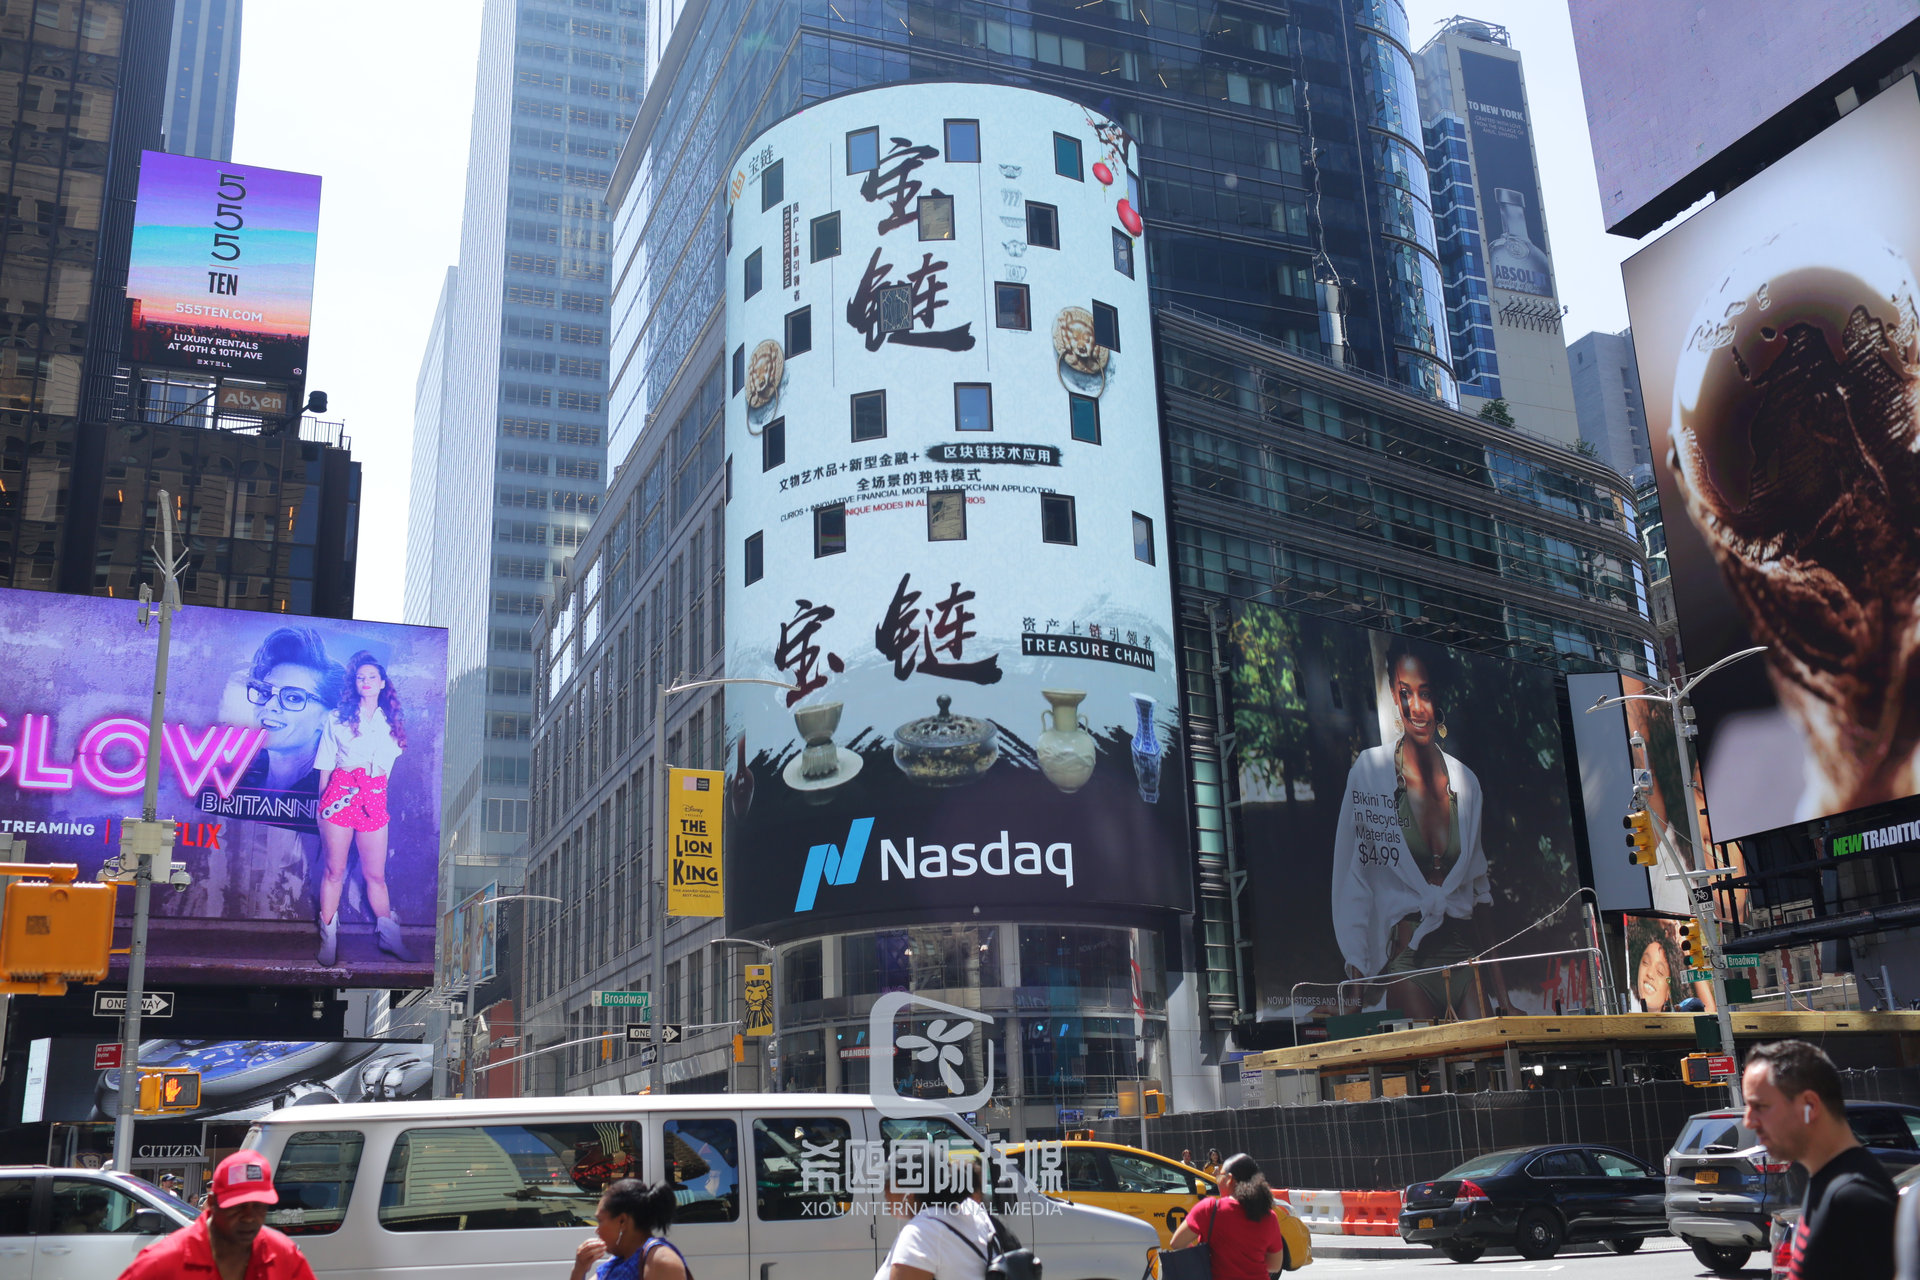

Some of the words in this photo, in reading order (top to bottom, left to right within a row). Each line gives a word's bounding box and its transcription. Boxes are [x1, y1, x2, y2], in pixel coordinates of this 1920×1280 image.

[1468, 100, 1479, 110] TO
[1481, 104, 1499, 115] NEW
[208, 271, 238, 296] TEN
[176, 303, 263, 322] 555TEN.COM
[174, 333, 214, 344] LUXURY
[216, 338, 258, 350] RENTALS
[183, 345, 208, 354] 40TH
[210, 347, 216, 355] &
[219, 348, 241, 358] 10TH
[243, 351, 263, 360] AVE
[224, 391, 282, 411] Absen
[943, 445, 1050, 463] 区块链技术应用
[857, 468, 981, 492] 全场景的独特模式
[780, 507, 804, 522] CURIOS
[857, 491, 900, 502] FINANCIAL
[902, 486, 930, 497] MODEL
[845, 504, 871, 516] NIQUE
[873, 501, 903, 512] MODES
[905, 500, 915, 508] IN
[1023, 638, 1110, 658] TREASURE
[1114, 648, 1153, 667] CHAIN
[0, 712, 268, 798] LOW
[1352, 790, 1379, 807] Bikini
[1381, 794, 1400, 812] Top
[680, 819, 706, 833] THE
[1354, 808, 1364, 822] in
[1366, 809, 1410, 829] Recycled
[0, 819, 95, 836] TREAMING
[1356, 825, 1401, 844] Materials
[880, 830, 1074, 888] Nasdaq
[1358, 841, 1400, 867] $4.99
[1728, 955, 1758, 967] Broadway
[1688, 972, 1695, 980] W
[106, 999, 127, 1009] ONE
[604, 993, 647, 1007] Broadway
[1267, 996, 1285, 1006] NOW
[1294, 996, 1321, 1006] STORES
[1322, 997, 1336, 1006] AND
[634, 1029, 649, 1038] ONE
[663, 1029, 673, 1038] AY
[138, 1144, 203, 1158] CITIZEN
